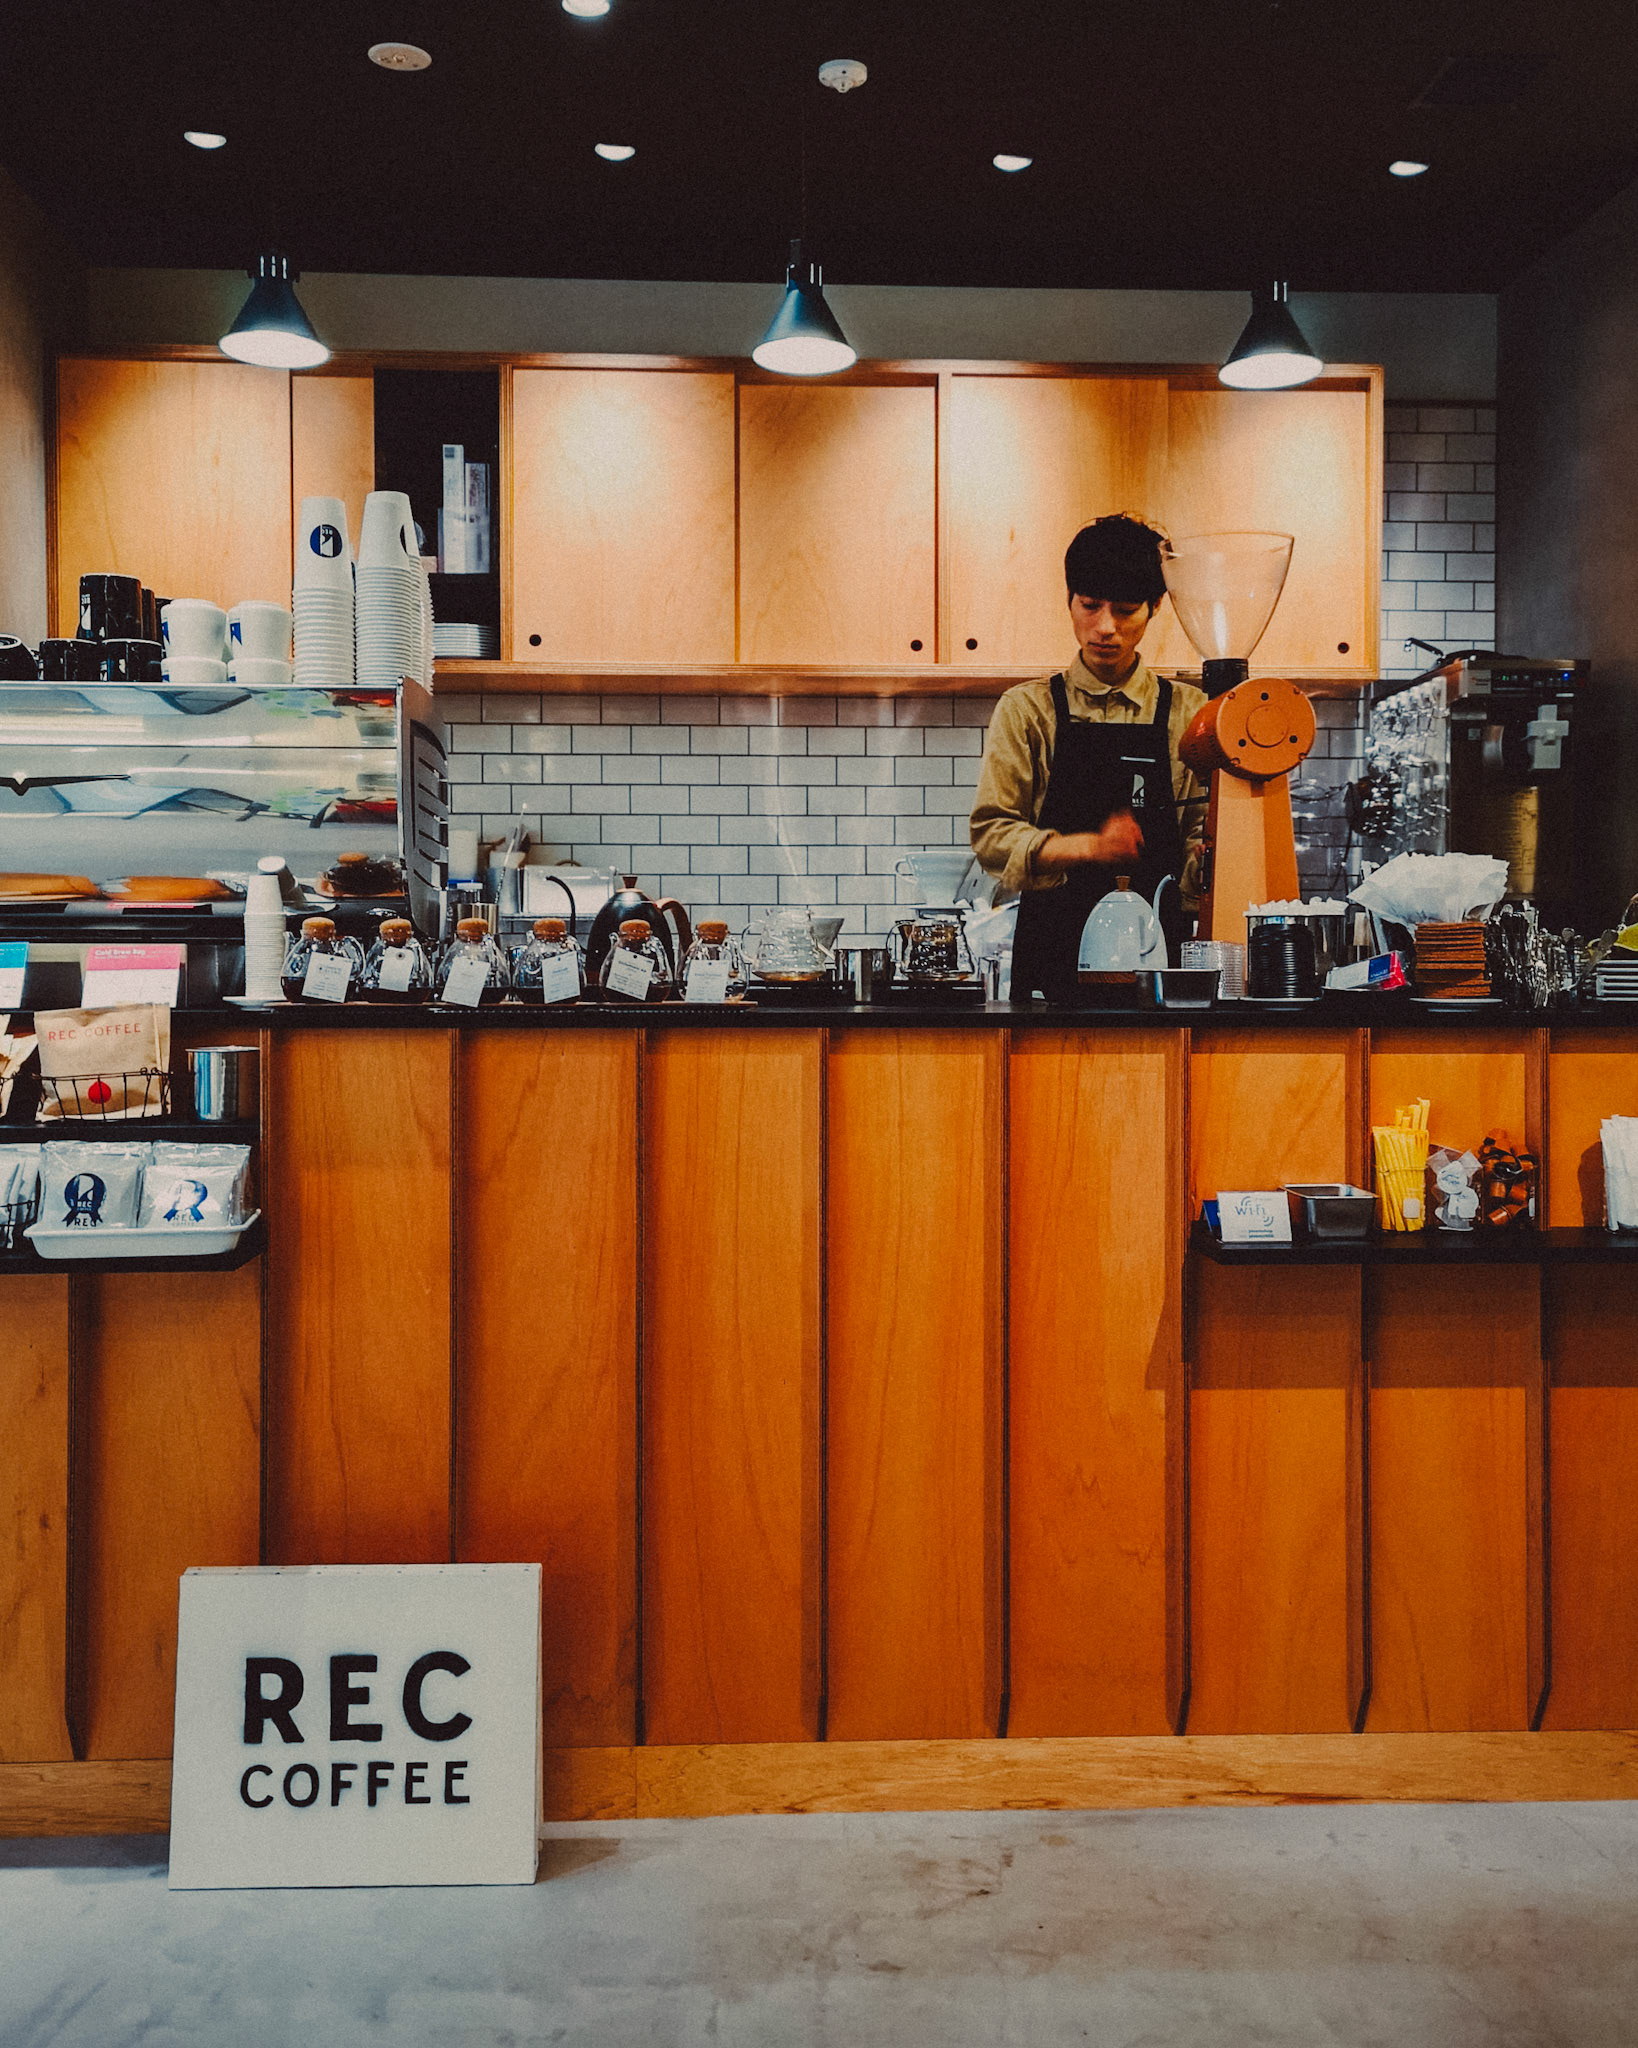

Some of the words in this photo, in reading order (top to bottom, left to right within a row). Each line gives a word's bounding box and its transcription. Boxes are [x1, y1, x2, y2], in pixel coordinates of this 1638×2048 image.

[48, 1030, 77, 1041] REC
[84, 1023, 141, 1037] COFFEE
[243, 1650, 473, 1744] REC
[240, 1760, 470, 1808] COFFEE
